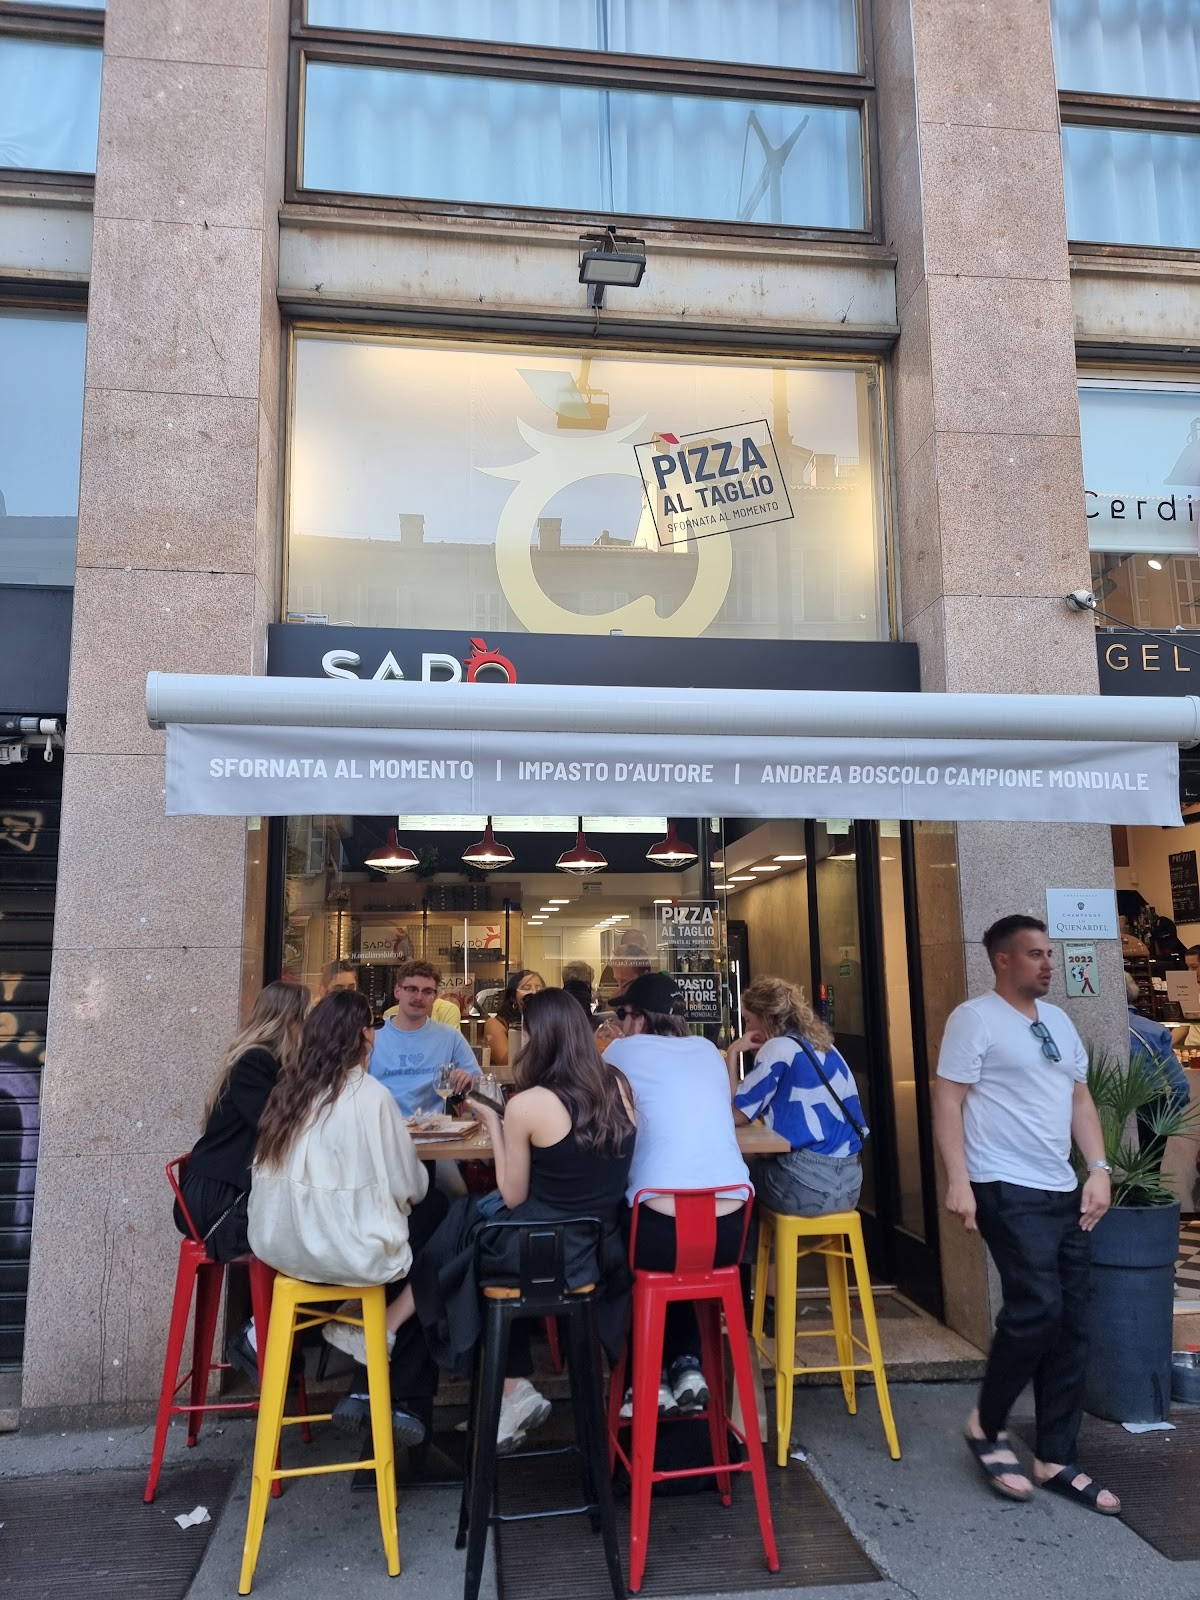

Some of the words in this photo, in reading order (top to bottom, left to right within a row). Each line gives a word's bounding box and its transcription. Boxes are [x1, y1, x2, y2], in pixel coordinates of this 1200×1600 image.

[651, 437, 767, 490] PIZZA
[663, 493, 693, 516] AL
[695, 475, 774, 508] TAGLIO
[667, 514, 717, 533] SFORNATA
[719, 510, 731, 522] AL
[733, 501, 779, 519] MOMENTO
[1105, 643, 1190, 671] GEL
[209, 758, 328, 778] SFORNATA
[334, 759, 363, 778] AL
[369, 759, 474, 780] MOMENTO
[518, 761, 609, 782] IMPASTO
[760, 764, 843, 784] ANDREA
[848, 765, 939, 786] BOSCOLO
[944, 766, 1044, 788] CAMPIONE
[1049, 769, 1150, 791] MONDIALE
[661, 906, 714, 925] PIZZA
[661, 926, 676, 937] AL
[678, 926, 715, 937] TAGLIO
[1068, 955, 1094, 963] 2022
[674, 978, 714, 990] PASTO
